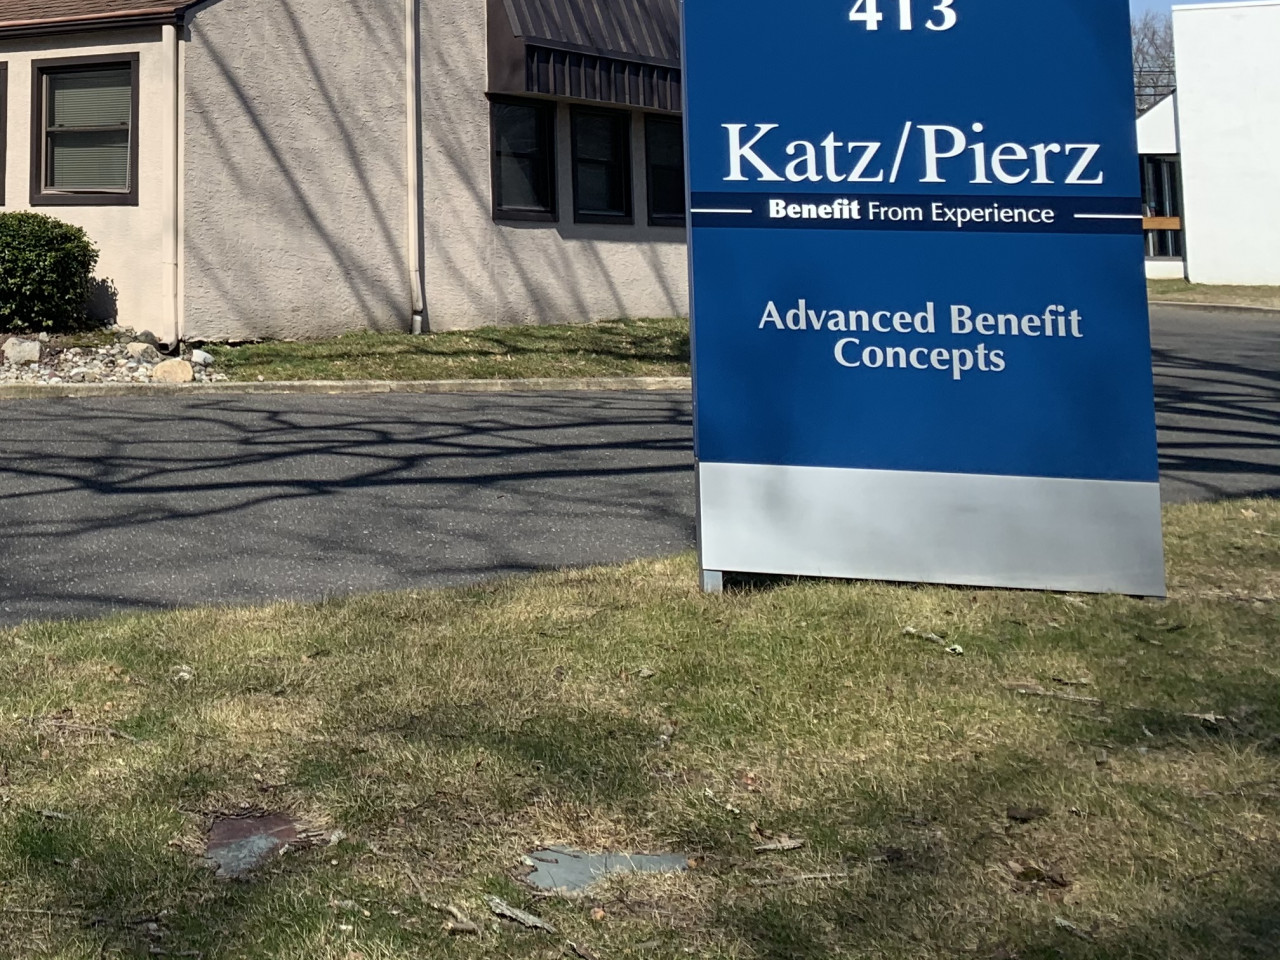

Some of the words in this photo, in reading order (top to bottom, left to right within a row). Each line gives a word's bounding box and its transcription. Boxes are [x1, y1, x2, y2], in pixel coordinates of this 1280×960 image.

[721, 121, 1104, 185] Katz/Pierz
[769, 198, 862, 220] Benefit
[868, 201, 923, 222] From
[931, 202, 1055, 228] Experience
[758, 298, 936, 334] Advanced
[950, 304, 1084, 338] Benefit
[833, 337, 1006, 380] Concepts
